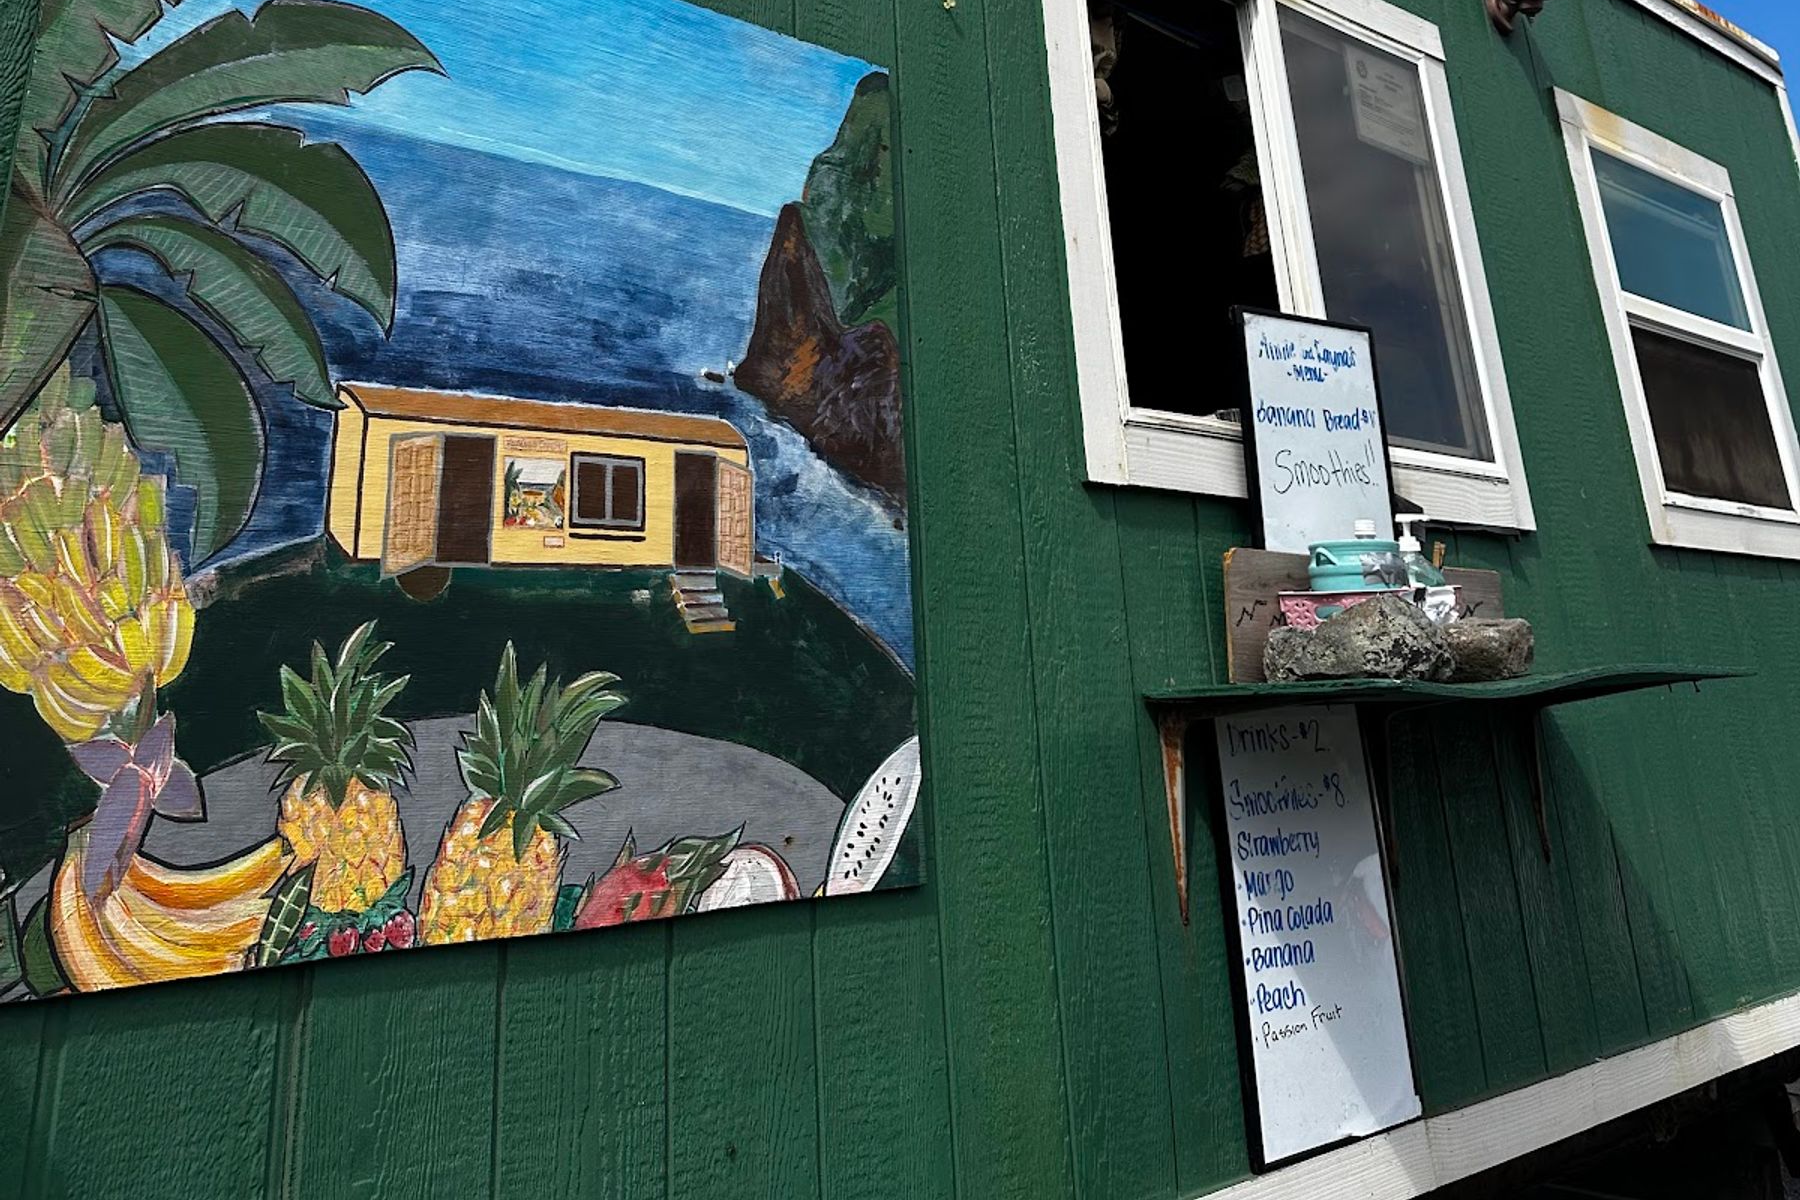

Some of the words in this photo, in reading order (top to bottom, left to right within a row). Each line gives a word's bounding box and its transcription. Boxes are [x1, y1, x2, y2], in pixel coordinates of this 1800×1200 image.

[1237, 827, 1320, 861] Strawberry
[1252, 940, 1316, 973] Banana
[1256, 980, 1306, 1014] Peach
[1261, 1021, 1308, 1049] Passion
[1311, 1003, 1342, 1030] Fruit
